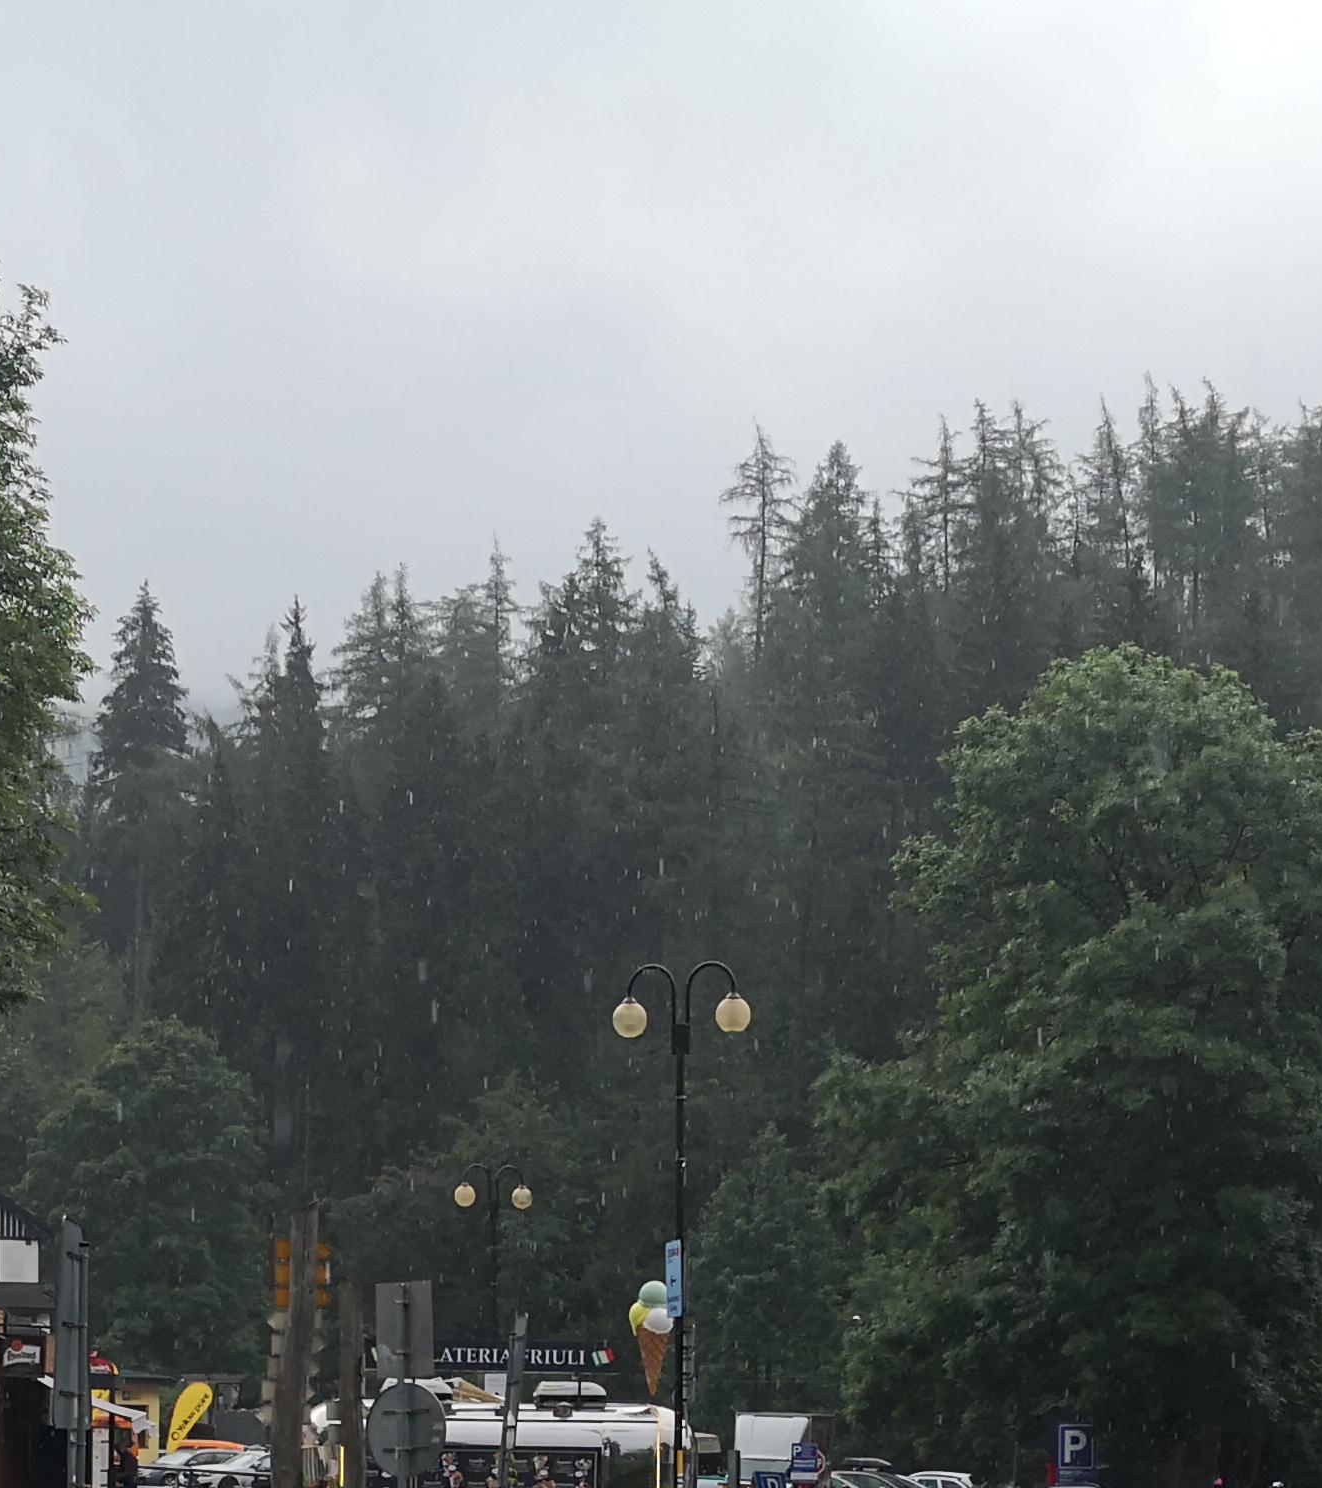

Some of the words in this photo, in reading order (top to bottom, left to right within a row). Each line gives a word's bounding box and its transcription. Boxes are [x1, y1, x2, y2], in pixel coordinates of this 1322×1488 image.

[433, 1346, 510, 1364] ATERIA
[793, 1445, 802, 1457] P
[1064, 1430, 1087, 1463] P
